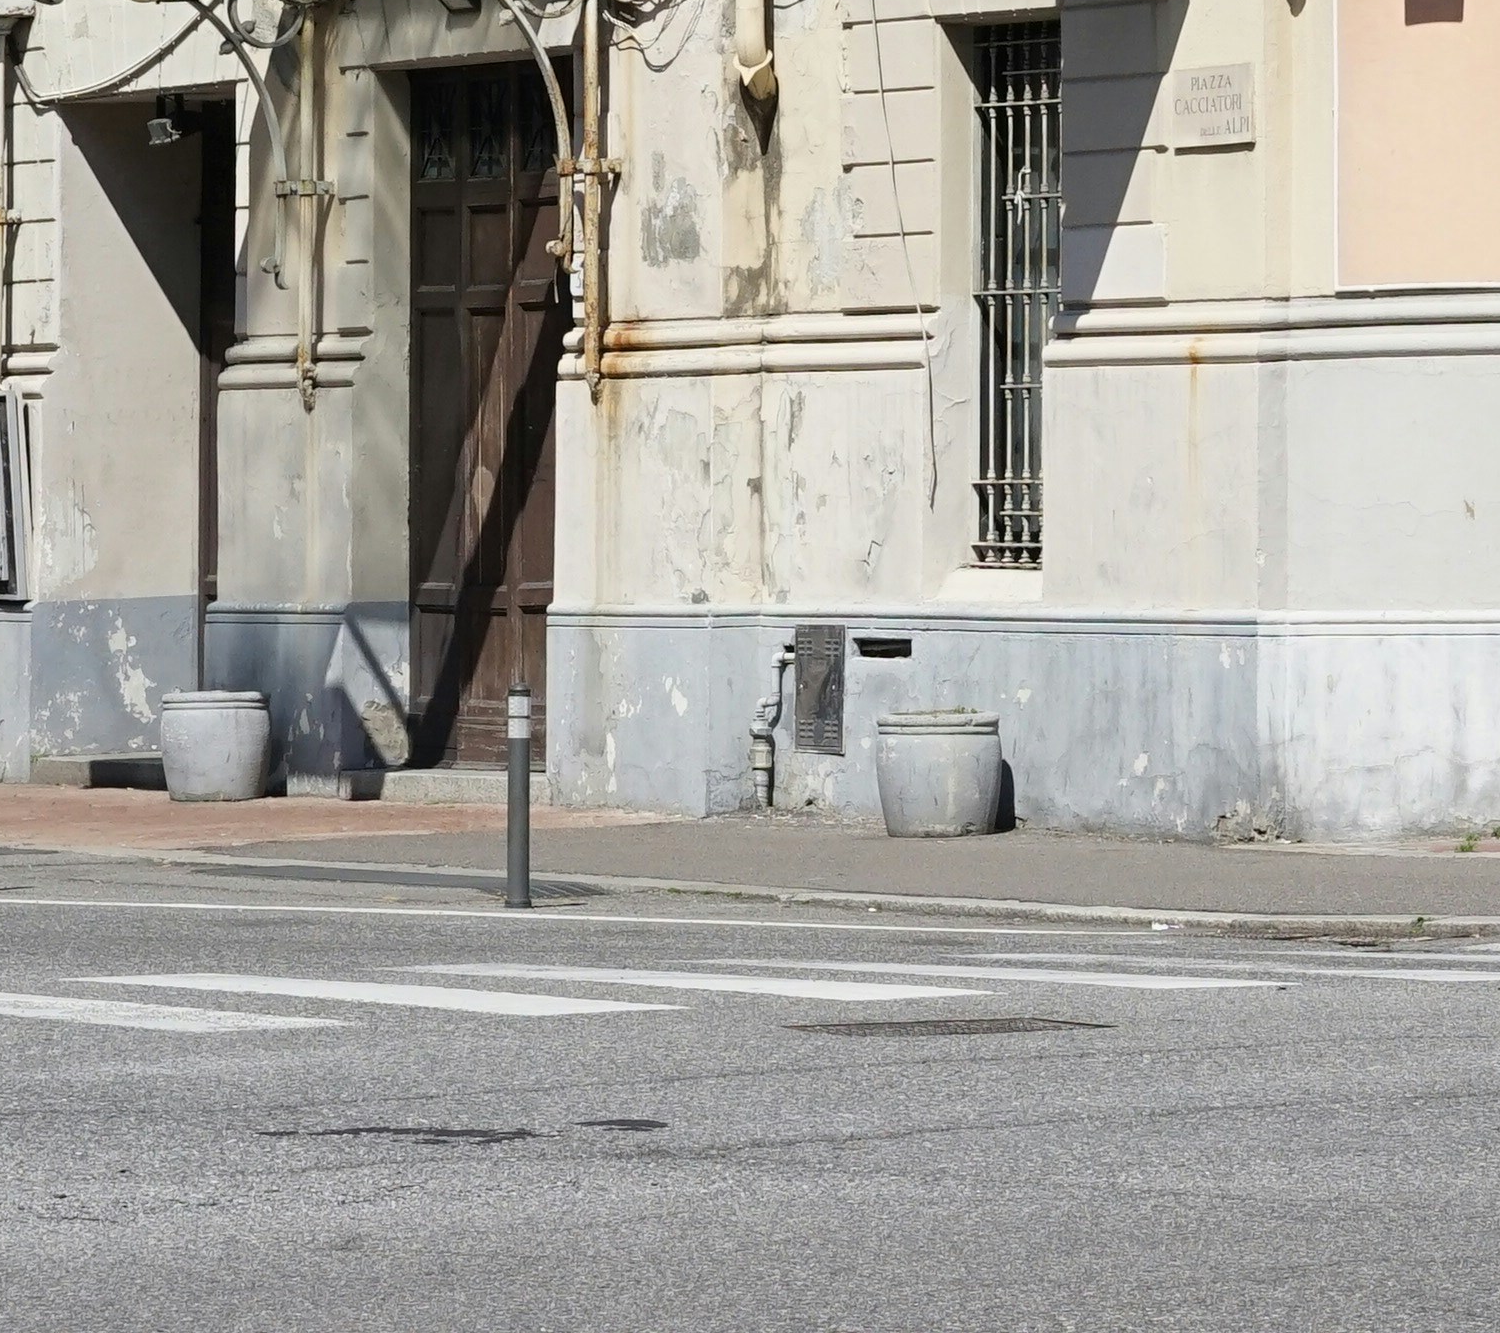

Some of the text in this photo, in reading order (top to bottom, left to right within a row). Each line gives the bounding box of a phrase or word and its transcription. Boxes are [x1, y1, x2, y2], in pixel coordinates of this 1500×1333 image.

[1190, 74, 1232, 91] PIAZZA
[1174, 93, 1242, 115] CACCIATORI
[1225, 116, 1250, 134] ALPI
